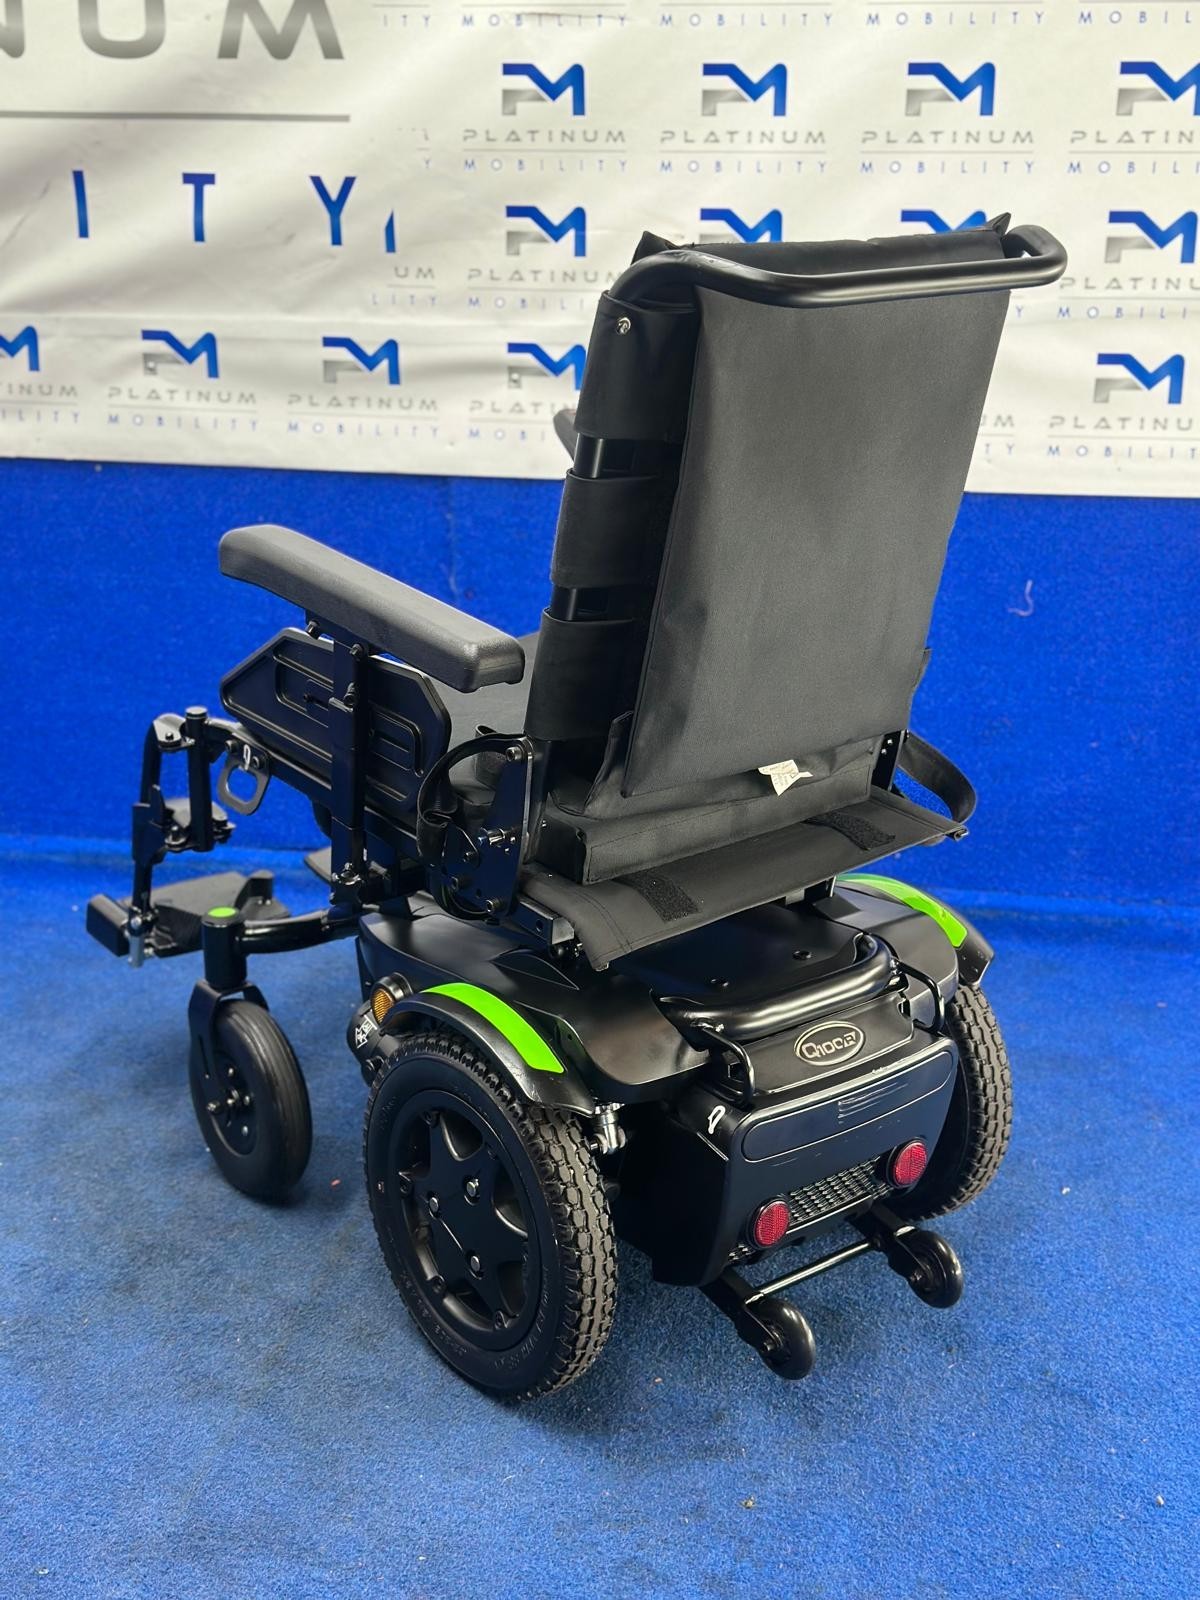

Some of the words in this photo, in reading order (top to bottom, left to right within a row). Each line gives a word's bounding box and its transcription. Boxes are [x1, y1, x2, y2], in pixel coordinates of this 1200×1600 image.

[461, 13, 627, 27] MOBILITY
[659, 13, 833, 27] MOBILITY
[866, 11, 1045, 26] MOBILITY
[1078, 10, 1192, 25] MOBIL
[462, 129, 626, 144] PLATINUM
[659, 130, 827, 145] PLATINUM
[861, 130, 1035, 145] PLATINUM
[463, 158, 628, 172] MOBILITY
[659, 160, 827, 174] MOBILITY
[860, 161, 1035, 175] MOBILITY
[107, 386, 257, 404] PLATINUM
[287, 393, 439, 412] PLATINUM
